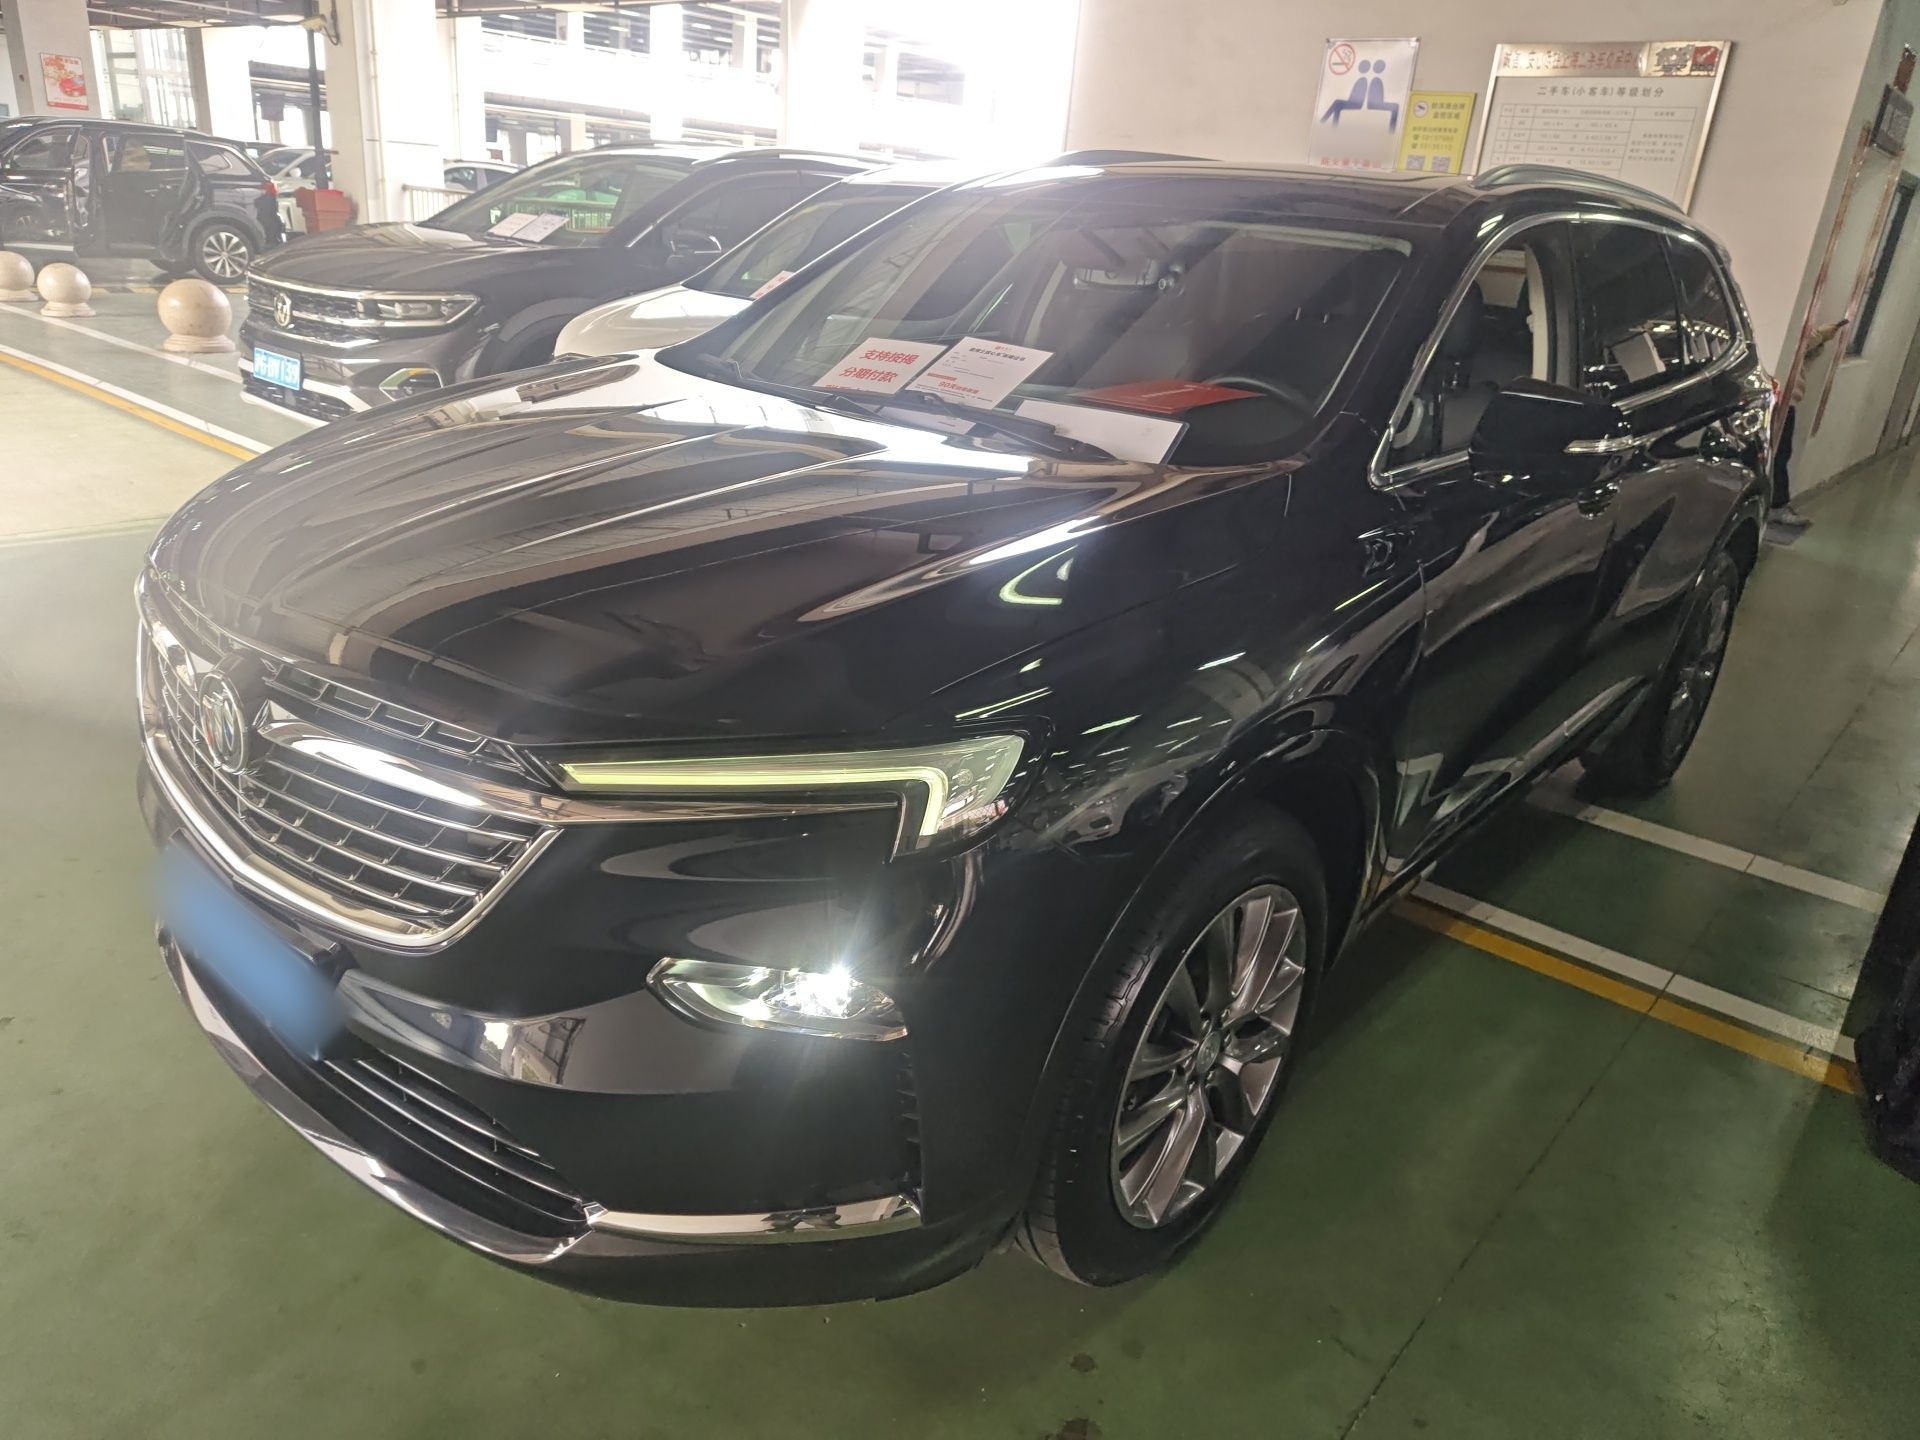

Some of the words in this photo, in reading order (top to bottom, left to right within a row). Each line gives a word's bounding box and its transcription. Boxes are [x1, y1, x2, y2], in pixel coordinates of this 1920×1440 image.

[860, 349, 920, 365] 支持按揭
[839, 366, 898, 383] 分期付款
